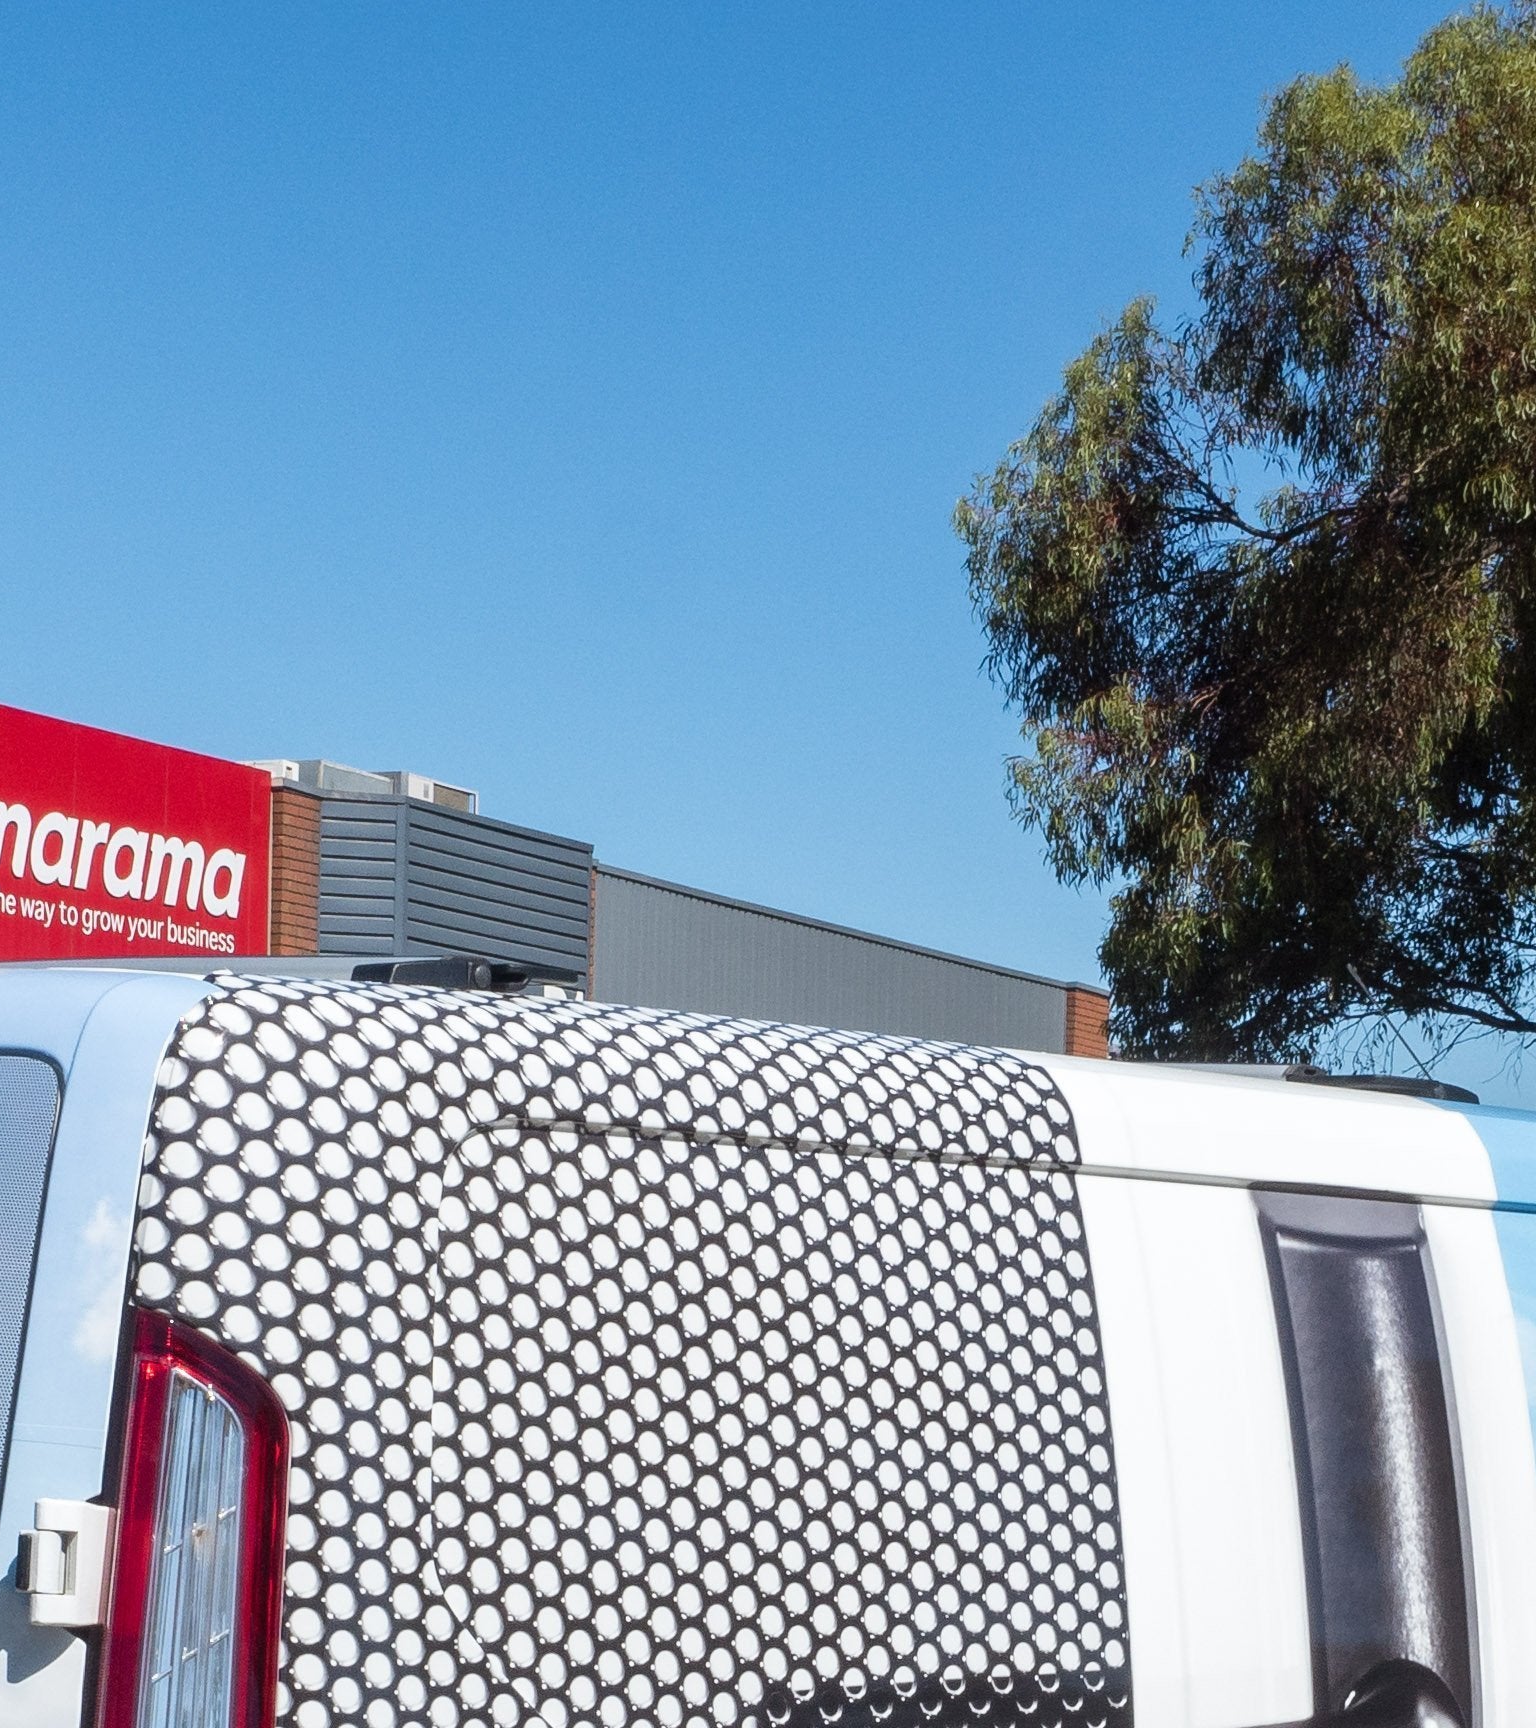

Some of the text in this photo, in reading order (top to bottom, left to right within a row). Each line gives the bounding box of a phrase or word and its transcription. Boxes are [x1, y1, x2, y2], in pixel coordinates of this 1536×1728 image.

[20, 896, 53, 928] way
[59, 901, 78, 926] to
[82, 909, 126, 936] grow
[127, 919, 167, 942] your
[167, 917, 236, 954] business
